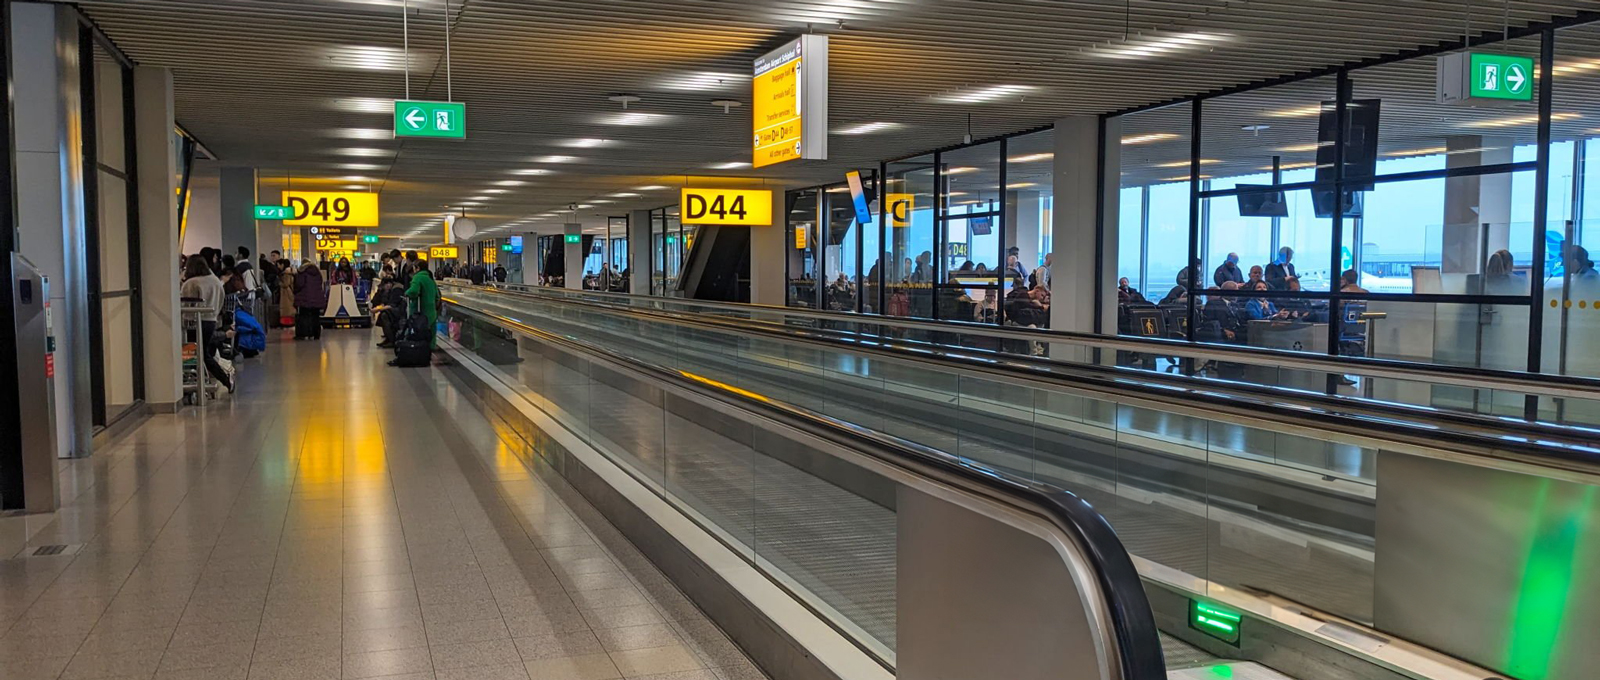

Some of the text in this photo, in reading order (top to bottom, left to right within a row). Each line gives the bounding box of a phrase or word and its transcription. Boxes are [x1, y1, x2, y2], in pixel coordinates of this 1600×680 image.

[287, 196, 350, 222] D49
[686, 194, 747, 220] D44
[318, 239, 343, 248] D51
